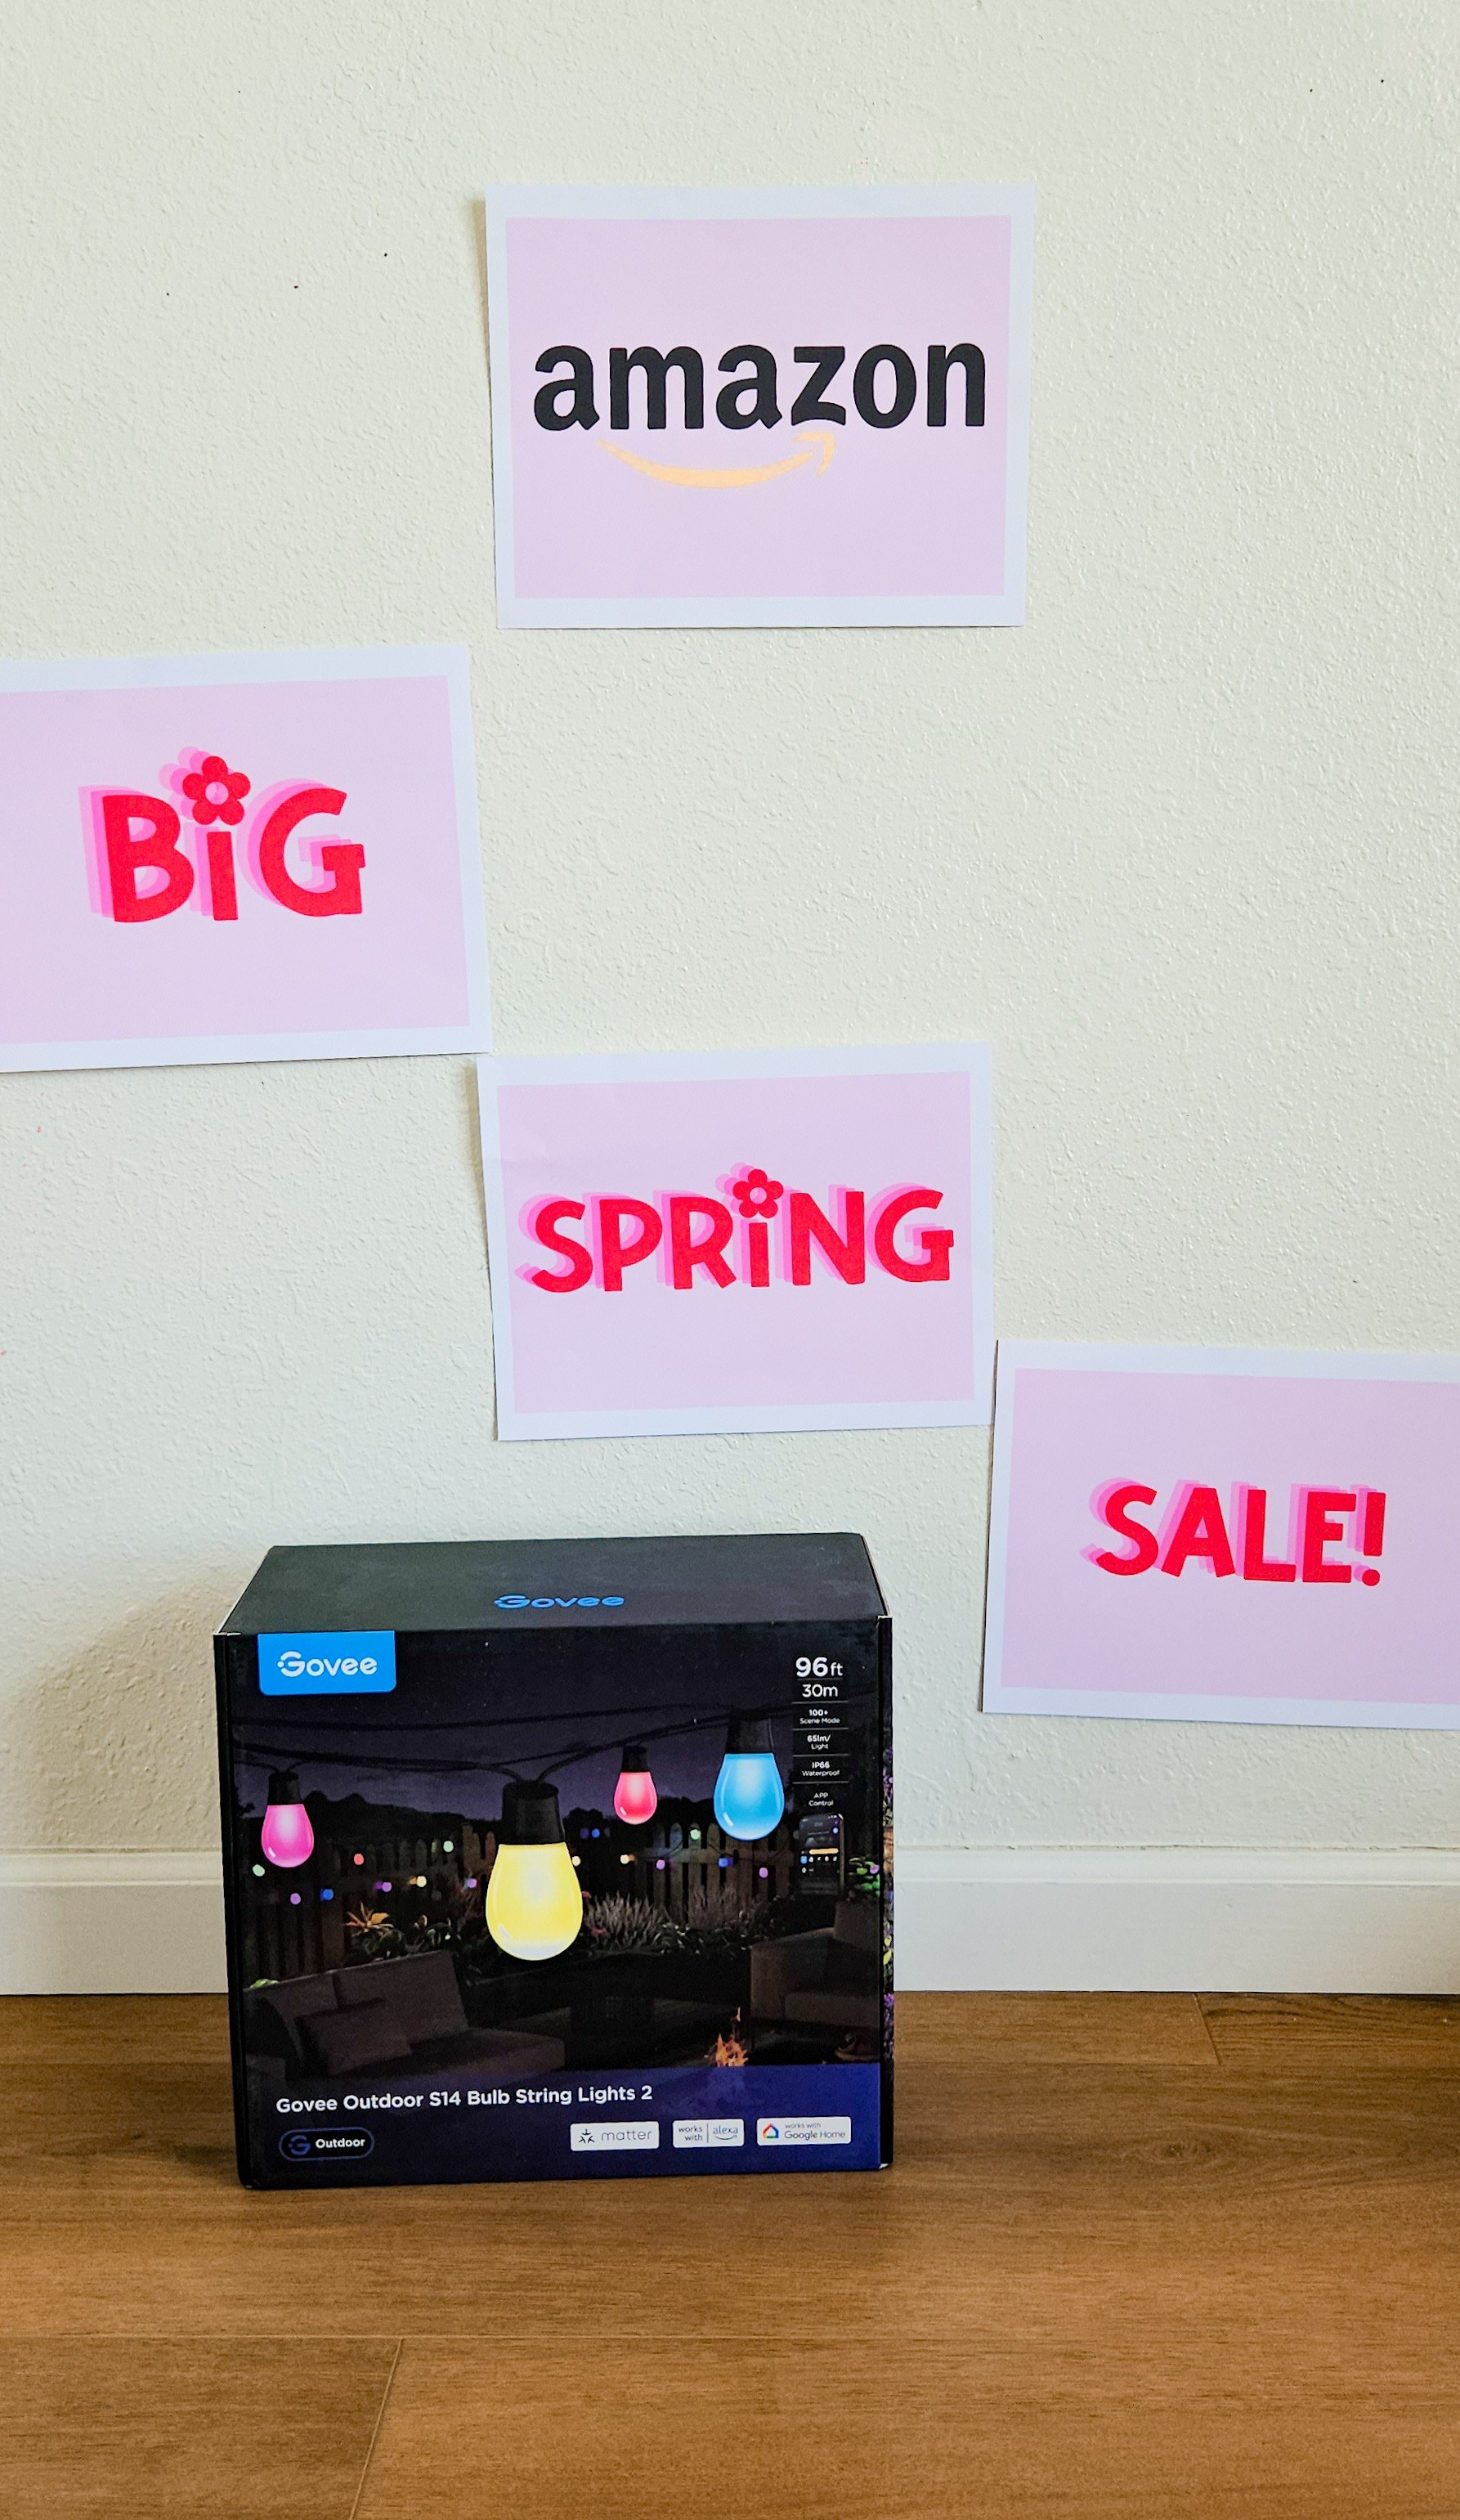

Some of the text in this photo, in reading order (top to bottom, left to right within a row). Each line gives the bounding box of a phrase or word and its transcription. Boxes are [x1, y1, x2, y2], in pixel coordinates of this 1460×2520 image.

[534, 343, 986, 431] amazon
[1092, 1482, 1387, 1587] SALE!
[494, 1593, 625, 1611] Govee
[277, 1650, 378, 1678] Govee
[795, 1656, 844, 1678] 96 ft
[802, 1684, 839, 1698] 30m
[810, 1742, 829, 1751] Light
[801, 1769, 840, 1778] Waterproof
[275, 2085, 653, 2114] Govee Outdoor S14 Bulb String Lights 2
[601, 2129, 652, 2141] matter
[678, 2124, 703, 2133] works
[712, 2124, 739, 2135] alexa
[784, 2129, 846, 2141] Google Home
[316, 2136, 365, 2150] Outdoor
[684, 2132, 703, 2142] with
